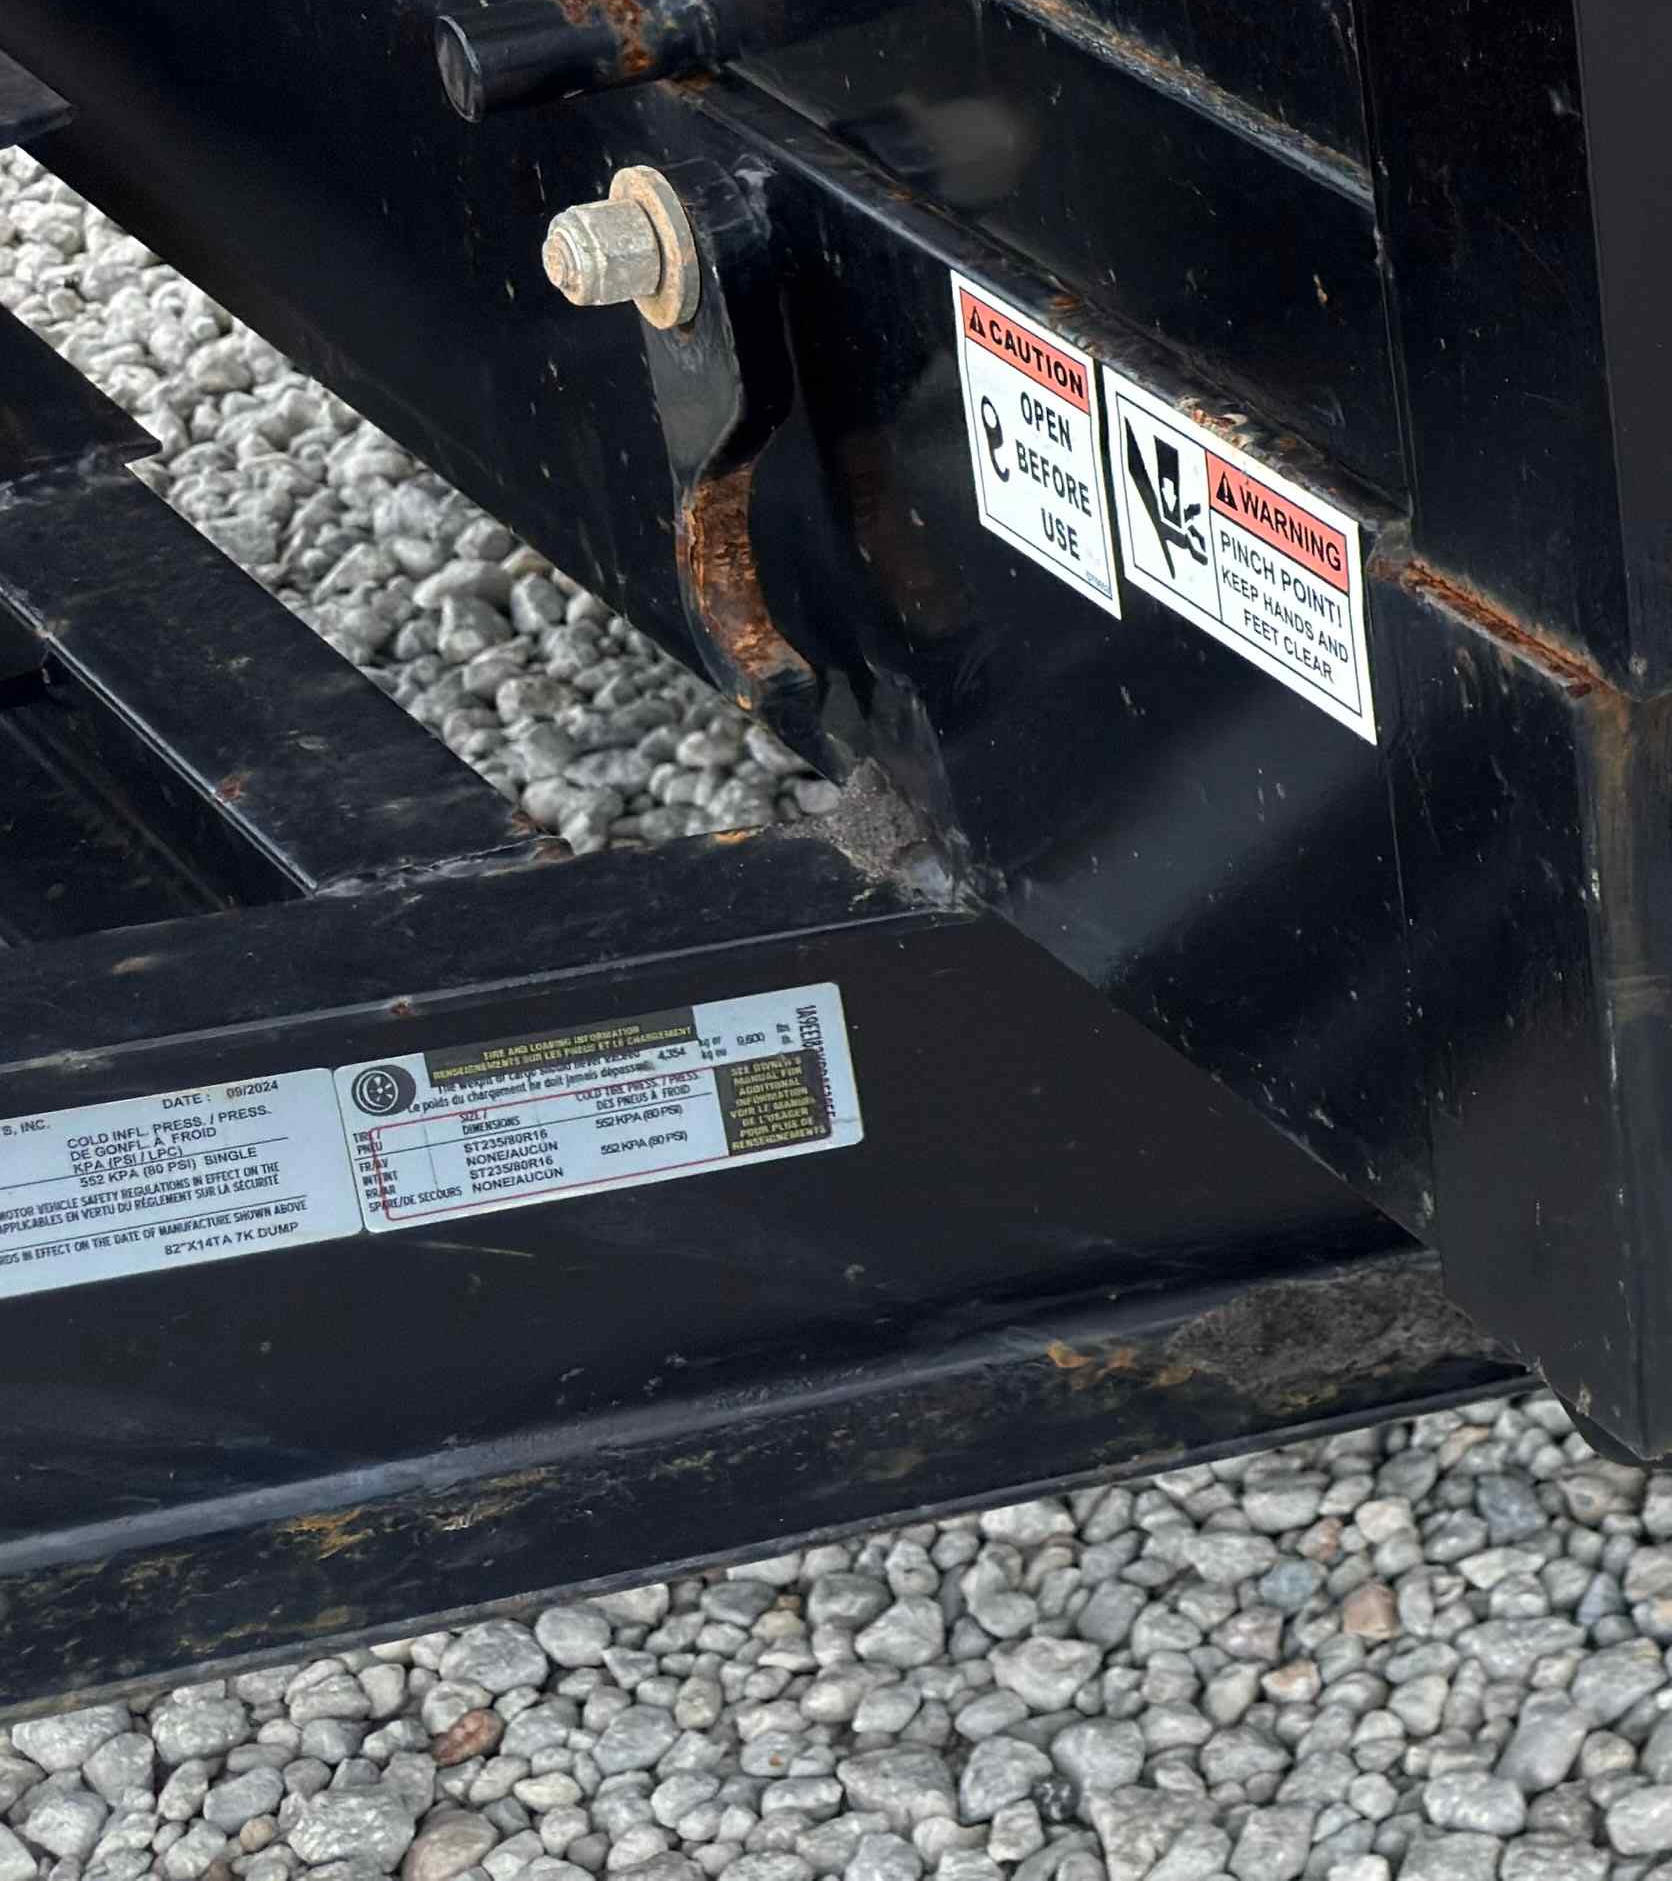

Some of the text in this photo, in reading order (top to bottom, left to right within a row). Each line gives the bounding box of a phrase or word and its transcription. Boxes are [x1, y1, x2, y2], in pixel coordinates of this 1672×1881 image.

[989, 319, 1083, 399] CAUTION
[1020, 391, 1072, 451] OPEN
[1015, 439, 1091, 517] BEFORE
[1041, 508, 1080, 560] USE
[1239, 485, 1341, 571] WARNING
[1220, 530, 1341, 627] PINCH POINT!
[1221, 566, 1348, 662] KEEP HANDS AND
[1243, 608, 1332, 680] FEET CLEAR
[162, 1079, 279, 1110] DATE 09/2024
[20, 1118, 51, 1135] INC.
[66, 1131, 109, 1150] COLD
[112, 1124, 149, 1142] INFL.
[152, 1114, 208, 1135] PRESS.
[217, 1103, 272, 1124] PRESS.
[70, 1126, 217, 1162] DE GONFL. FROID
[462, 1129, 548, 1153] ST235/80R16
[72, 1158, 105, 1175] KPA
[108, 1152, 137, 1169] (PSI
[148, 1144, 183, 1162] LPC)
[79, 1146, 258, 1190] 552 KPA (80 PSI) SINGLE
[465, 1141, 559, 1167] NONE/AUCUN
[468, 1155, 554, 1180] ST235/80R16
[471, 1167, 565, 1193] NONE/AUCUN
[234, 1229, 255, 1243] 7K
[257, 1220, 299, 1239] DUMP
